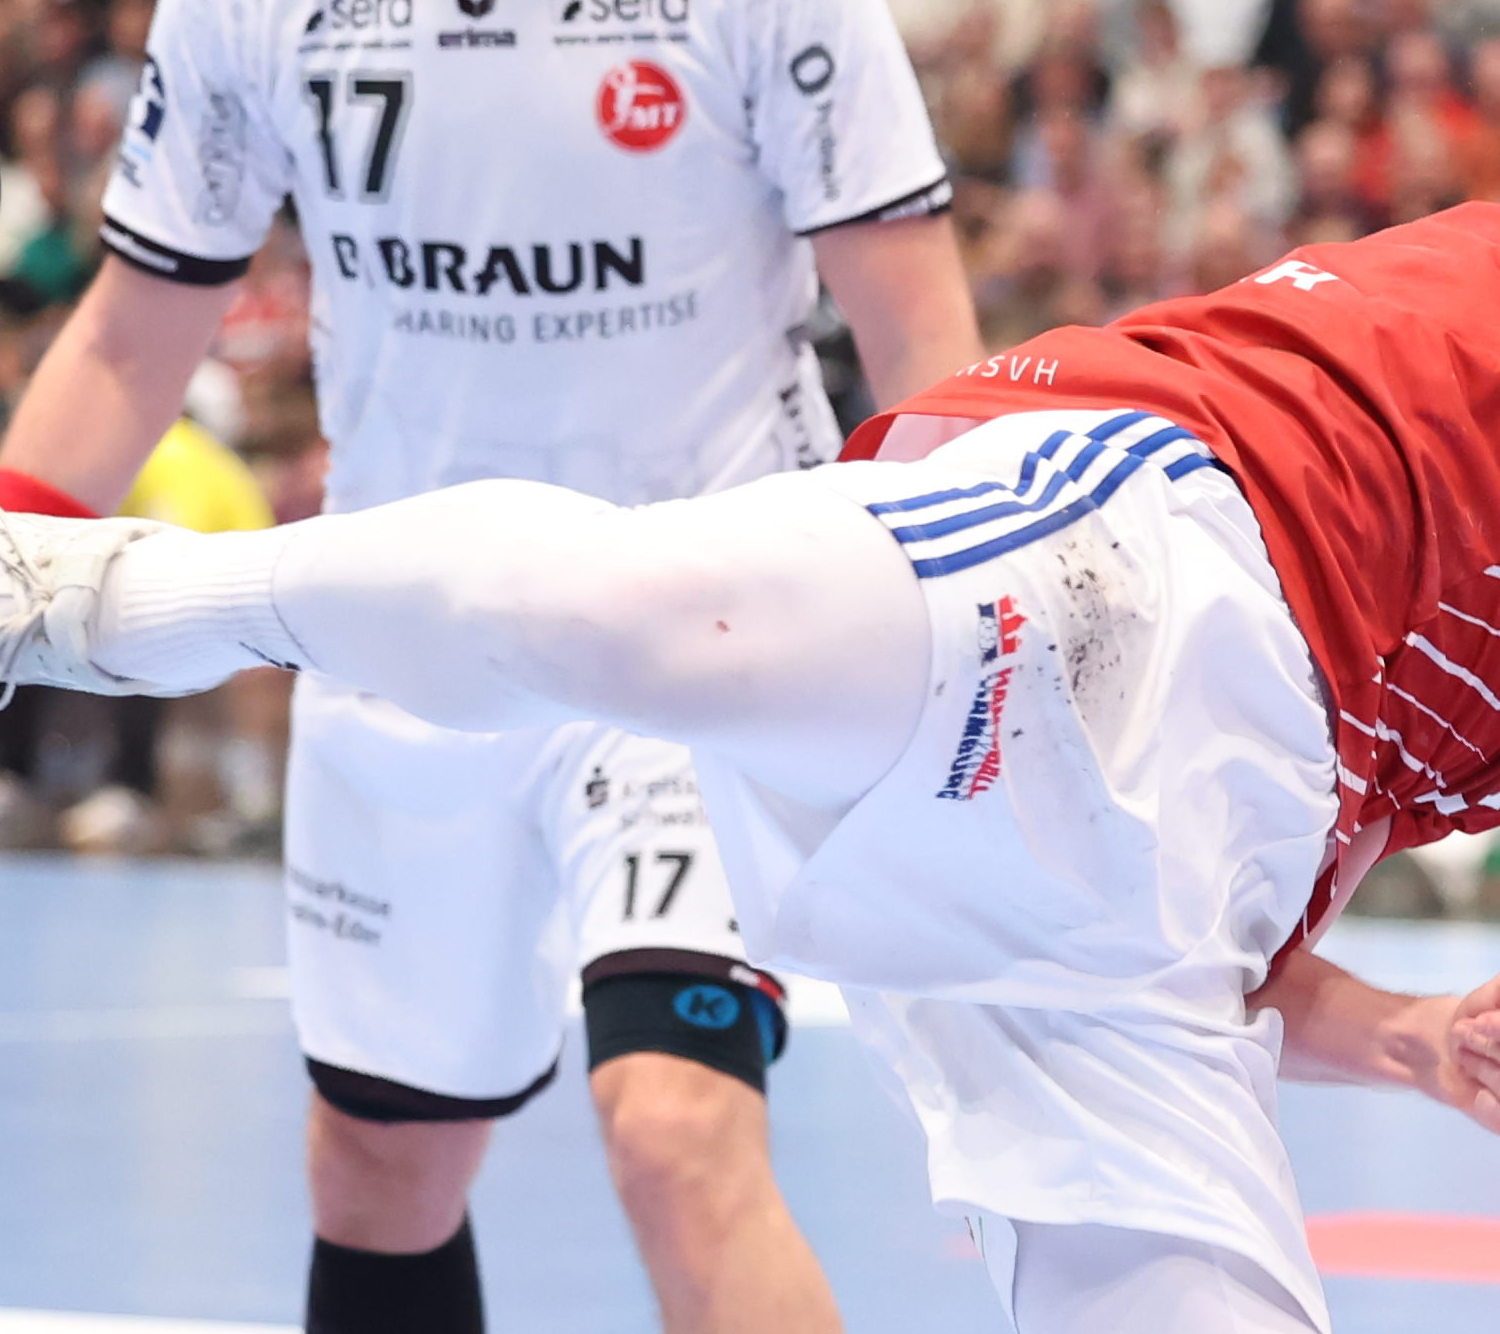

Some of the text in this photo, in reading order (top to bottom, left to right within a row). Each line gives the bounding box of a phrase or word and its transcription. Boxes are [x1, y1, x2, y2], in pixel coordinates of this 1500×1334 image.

[437, 28, 517, 49] erima
[303, 69, 414, 204] 17
[376, 235, 645, 297] BRAUN
[533, 291, 700, 344] EXPERTISE
[621, 850, 695, 922] 17
